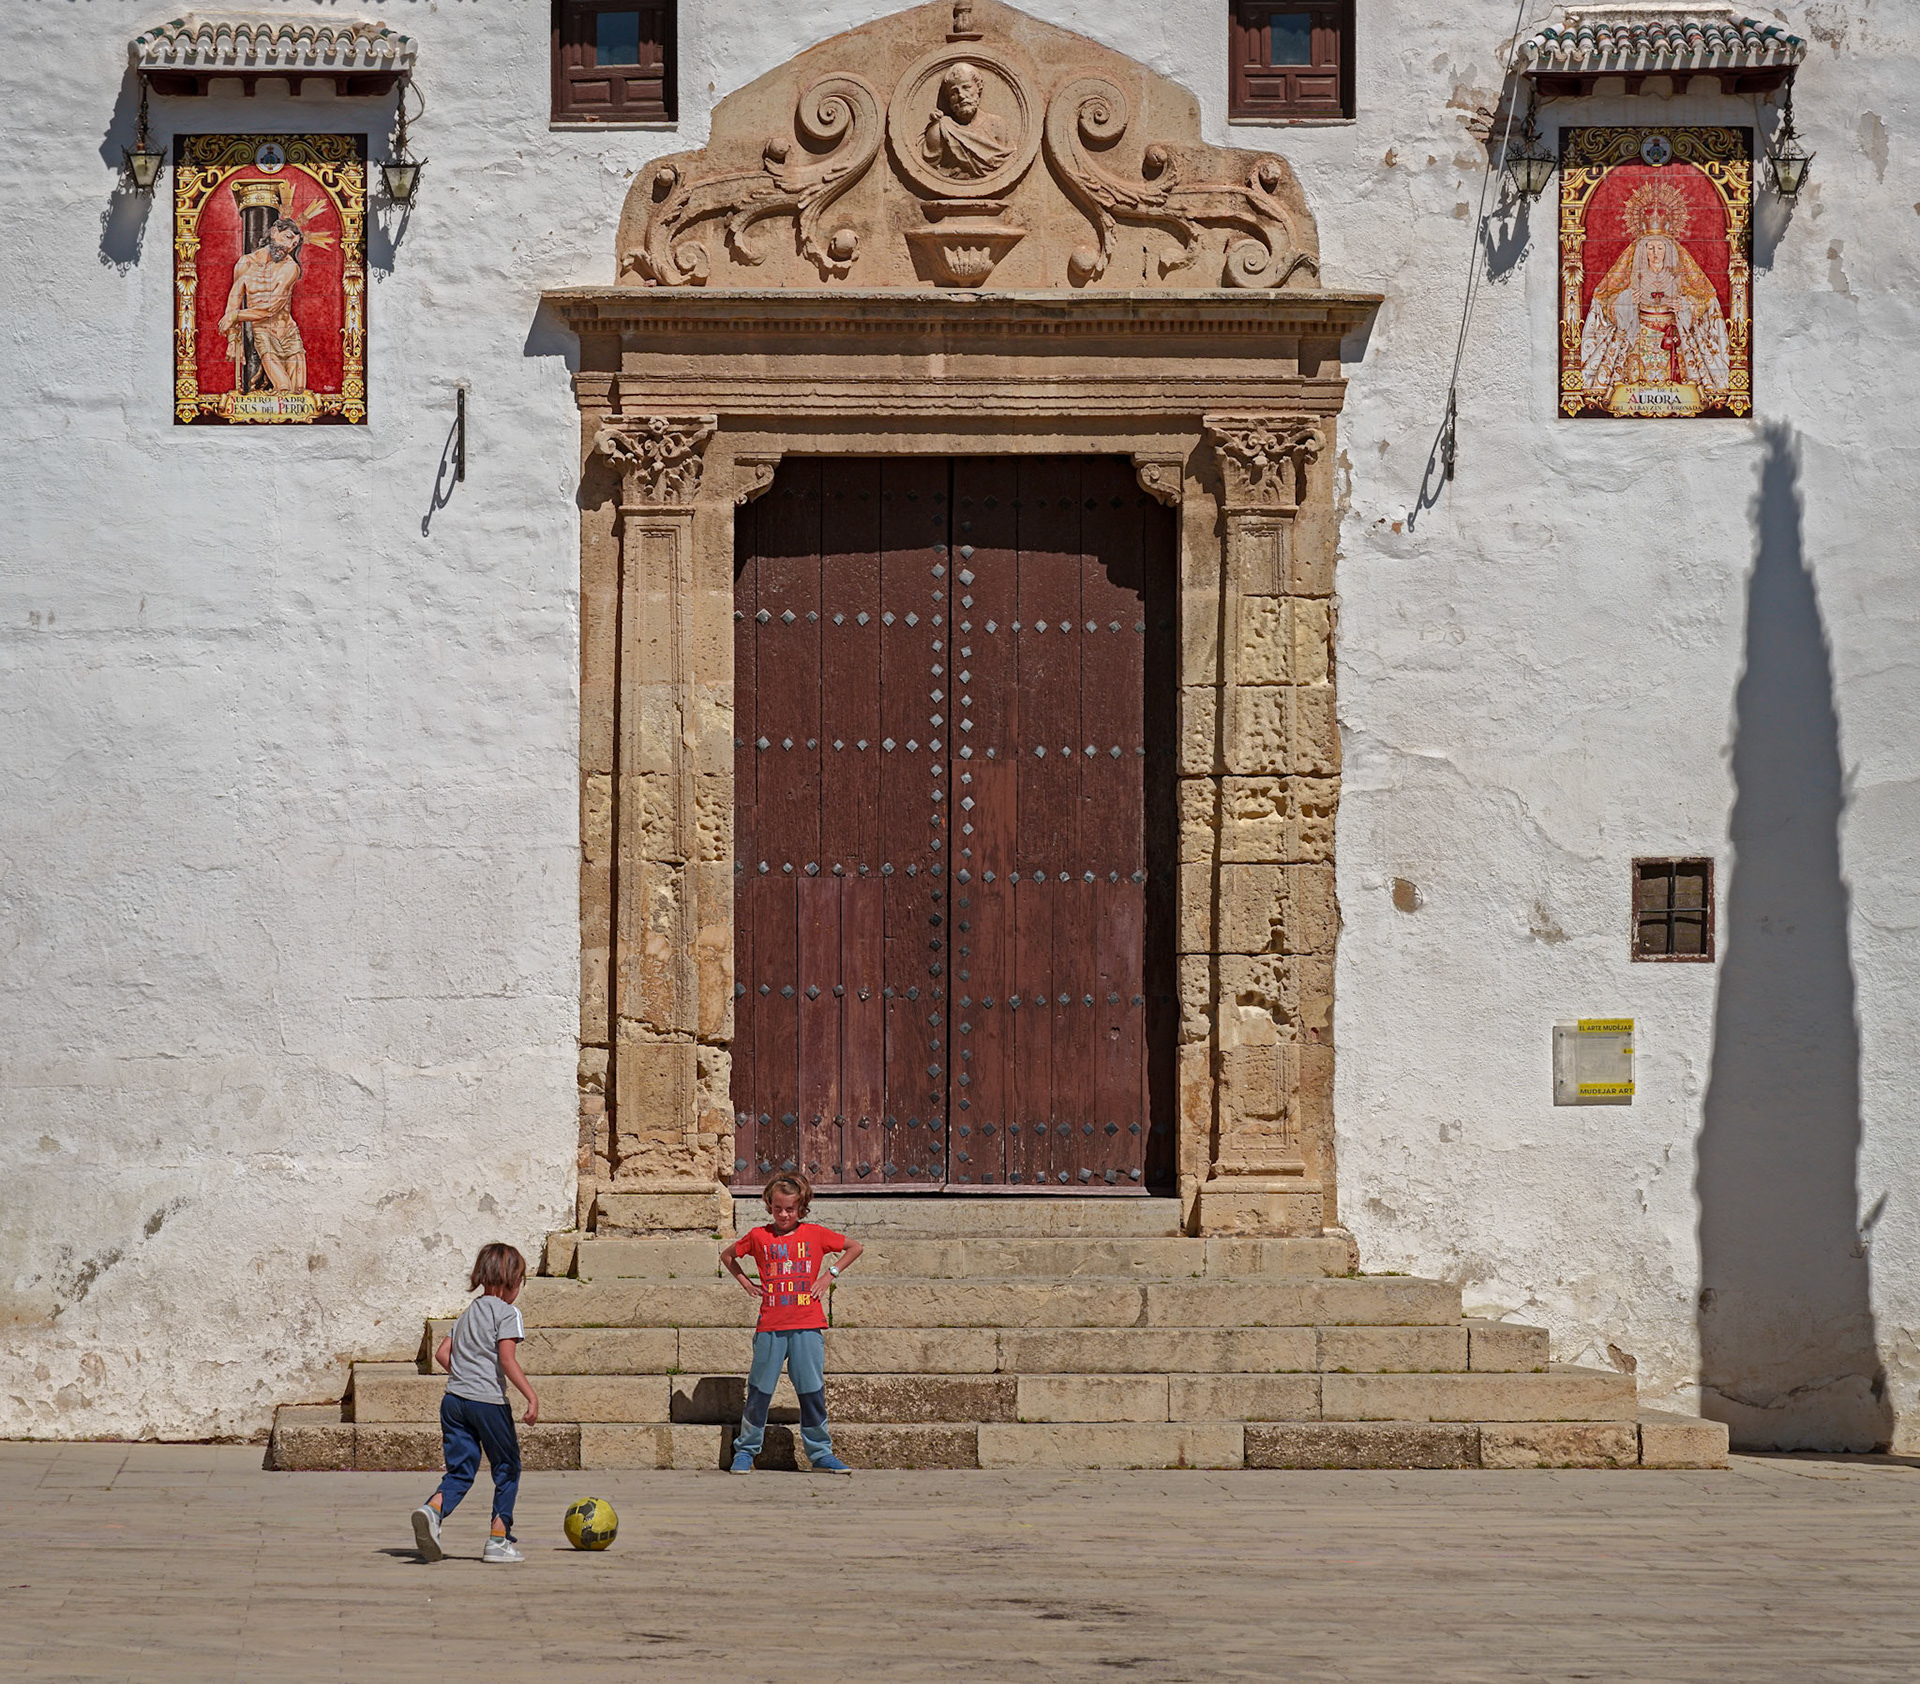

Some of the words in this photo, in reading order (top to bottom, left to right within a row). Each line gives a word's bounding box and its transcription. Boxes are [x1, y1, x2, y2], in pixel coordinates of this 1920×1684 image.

[1627, 393, 1682, 405] AURORA
[227, 403, 257, 414] JESUS
[278, 403, 315, 415] PERDON
[763, 1244, 768, 1261] I
[770, 1243, 788, 1260] AM
